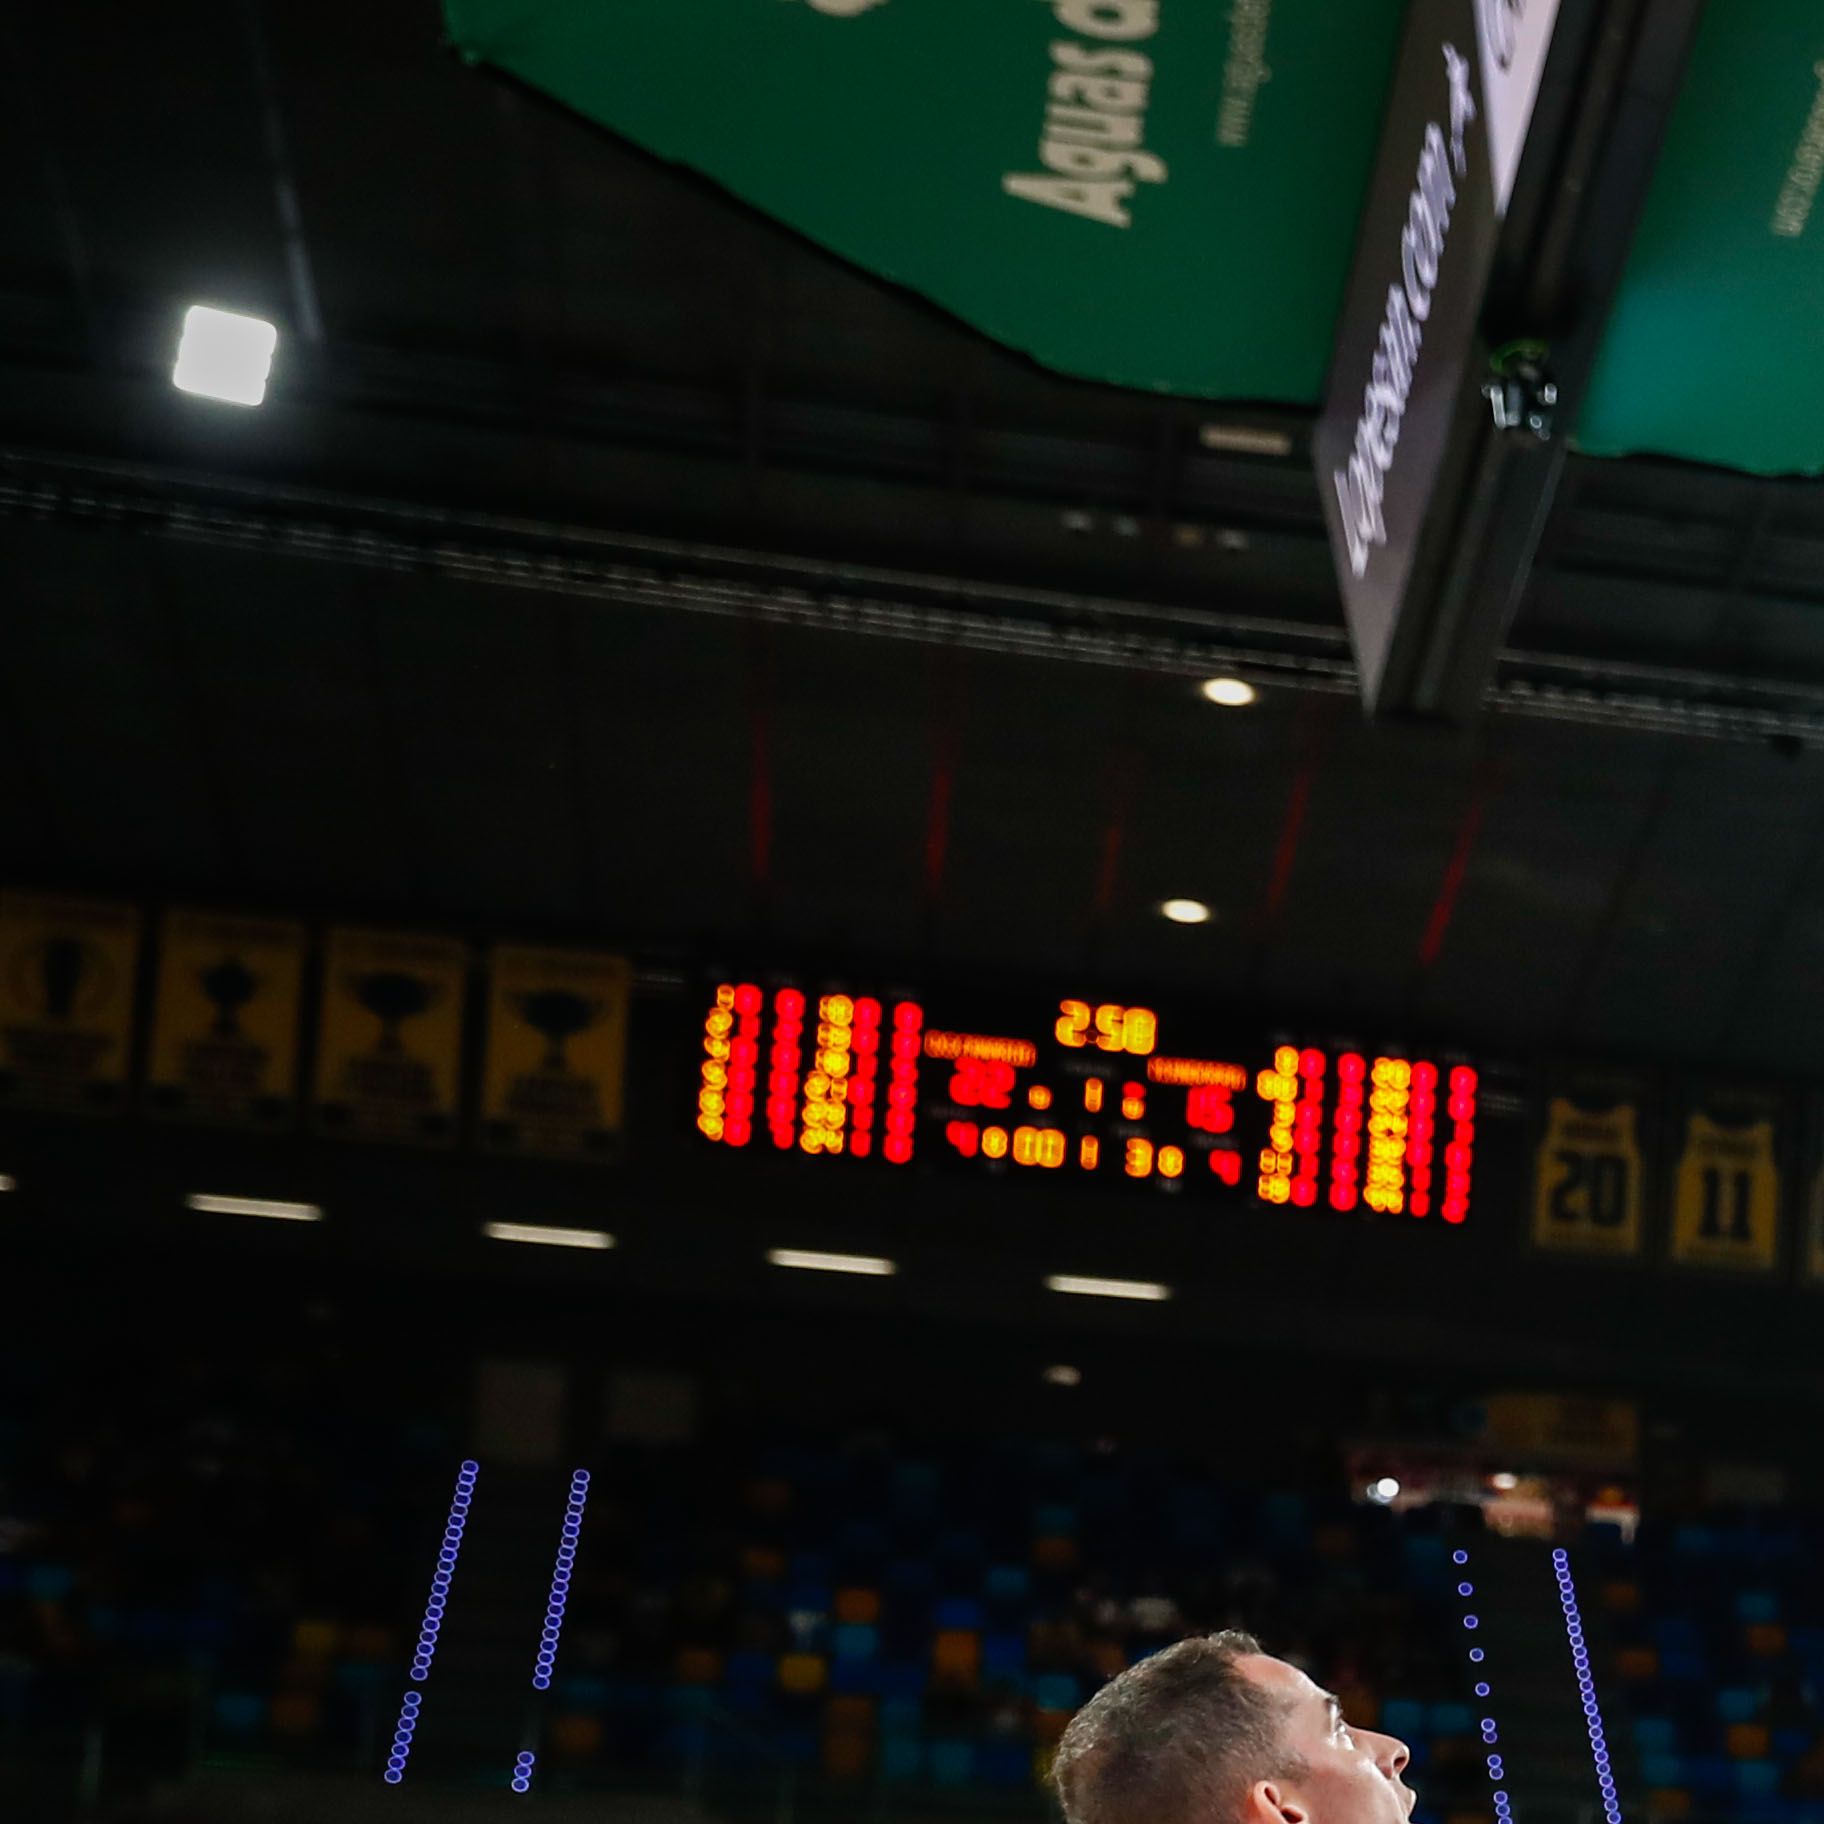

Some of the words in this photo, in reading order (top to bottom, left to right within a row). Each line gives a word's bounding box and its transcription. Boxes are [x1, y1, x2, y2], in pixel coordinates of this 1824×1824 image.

[1002, 40, 1168, 228] Aguas
[1549, 1149, 1630, 1228] 20
[1698, 1165, 1755, 1243] 11
